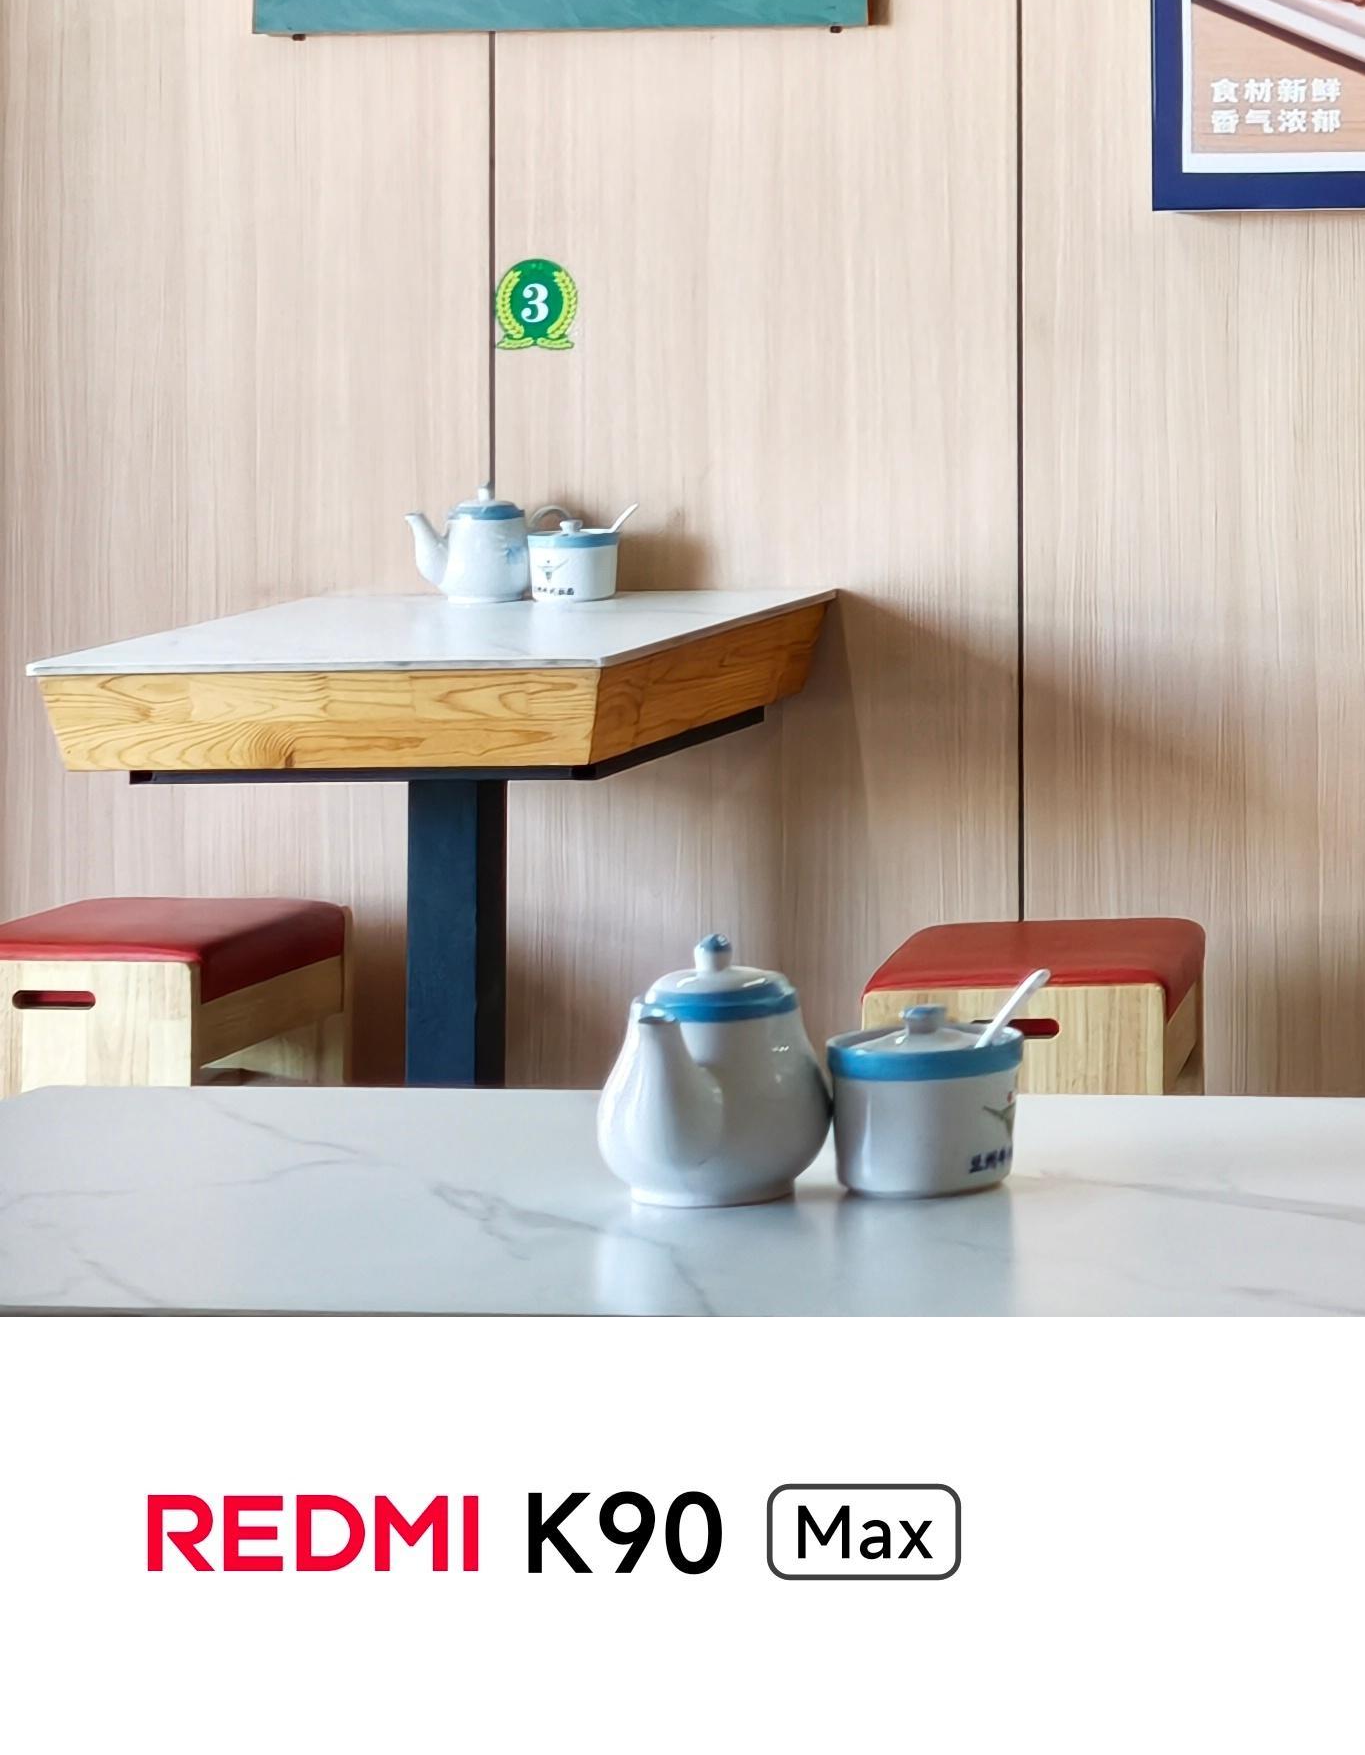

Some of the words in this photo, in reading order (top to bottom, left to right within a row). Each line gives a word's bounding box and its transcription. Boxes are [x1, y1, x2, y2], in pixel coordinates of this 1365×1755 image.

[1210, 78, 1342, 105] 食材新鲜
[1210, 107, 1342, 134] 香气浓郁
[520, 283, 548, 322] 3
